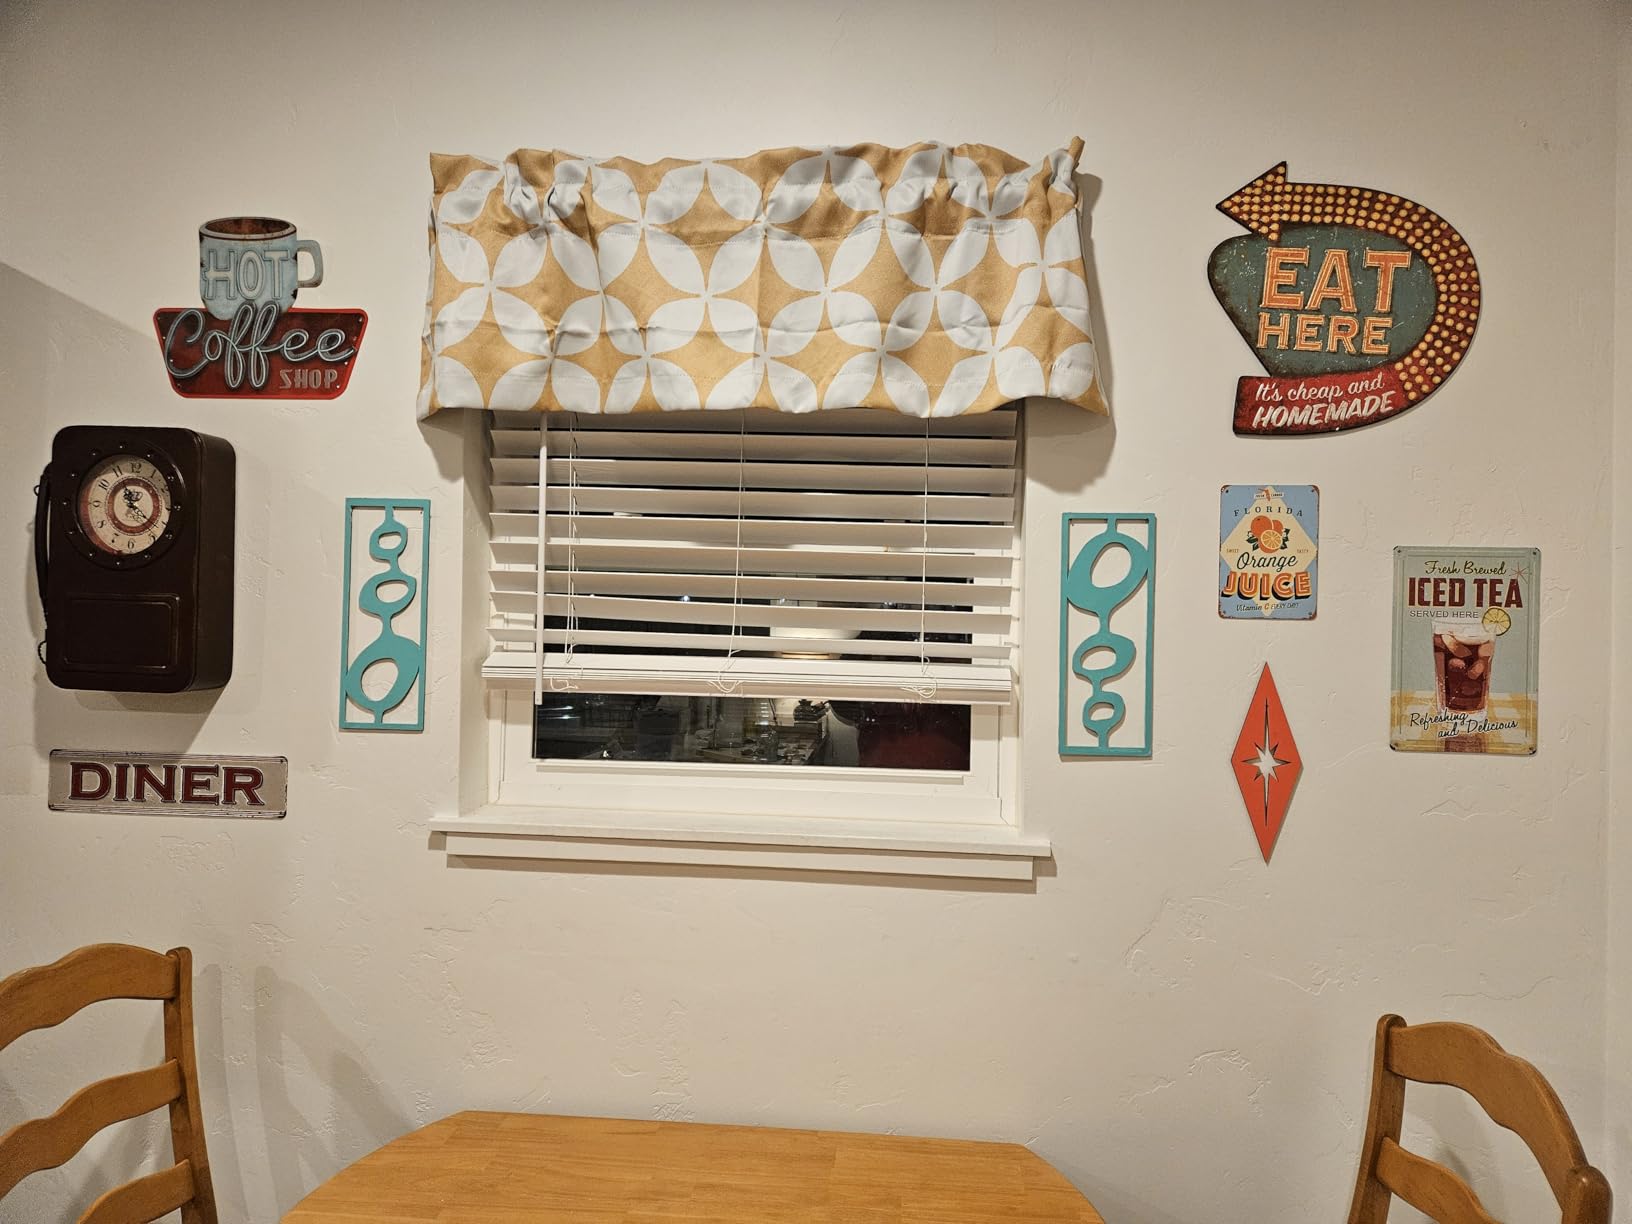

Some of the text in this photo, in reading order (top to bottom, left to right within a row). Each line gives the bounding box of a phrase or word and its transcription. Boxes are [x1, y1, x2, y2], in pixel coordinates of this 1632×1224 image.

[203, 249, 291, 301] HOT
[1259, 247, 1412, 313] EAT
[1256, 311, 1393, 355] HERE
[164, 301, 358, 391] Coffee
[279, 369, 338, 389] SHOP
[1255, 372, 1385, 403] It's cheap and
[1251, 391, 1396, 429] HOMEMADE
[130, 462, 142, 474] 12
[1233, 506, 1304, 517] FLORIDA
[1236, 551, 1298, 572] Orange
[1425, 560, 1507, 575] Fresh Brewed
[1221, 571, 1312, 600] JUICE
[1408, 577, 1523, 608] ICED TEA
[1236, 603, 1262, 612] Vitamin
[1264, 602, 1270, 610] C
[1409, 610, 1479, 619] SERVED HERE
[1409, 709, 1469, 728] Refreshing
[1437, 719, 1519, 739] and Delicious
[69, 762, 265, 806] DINER
